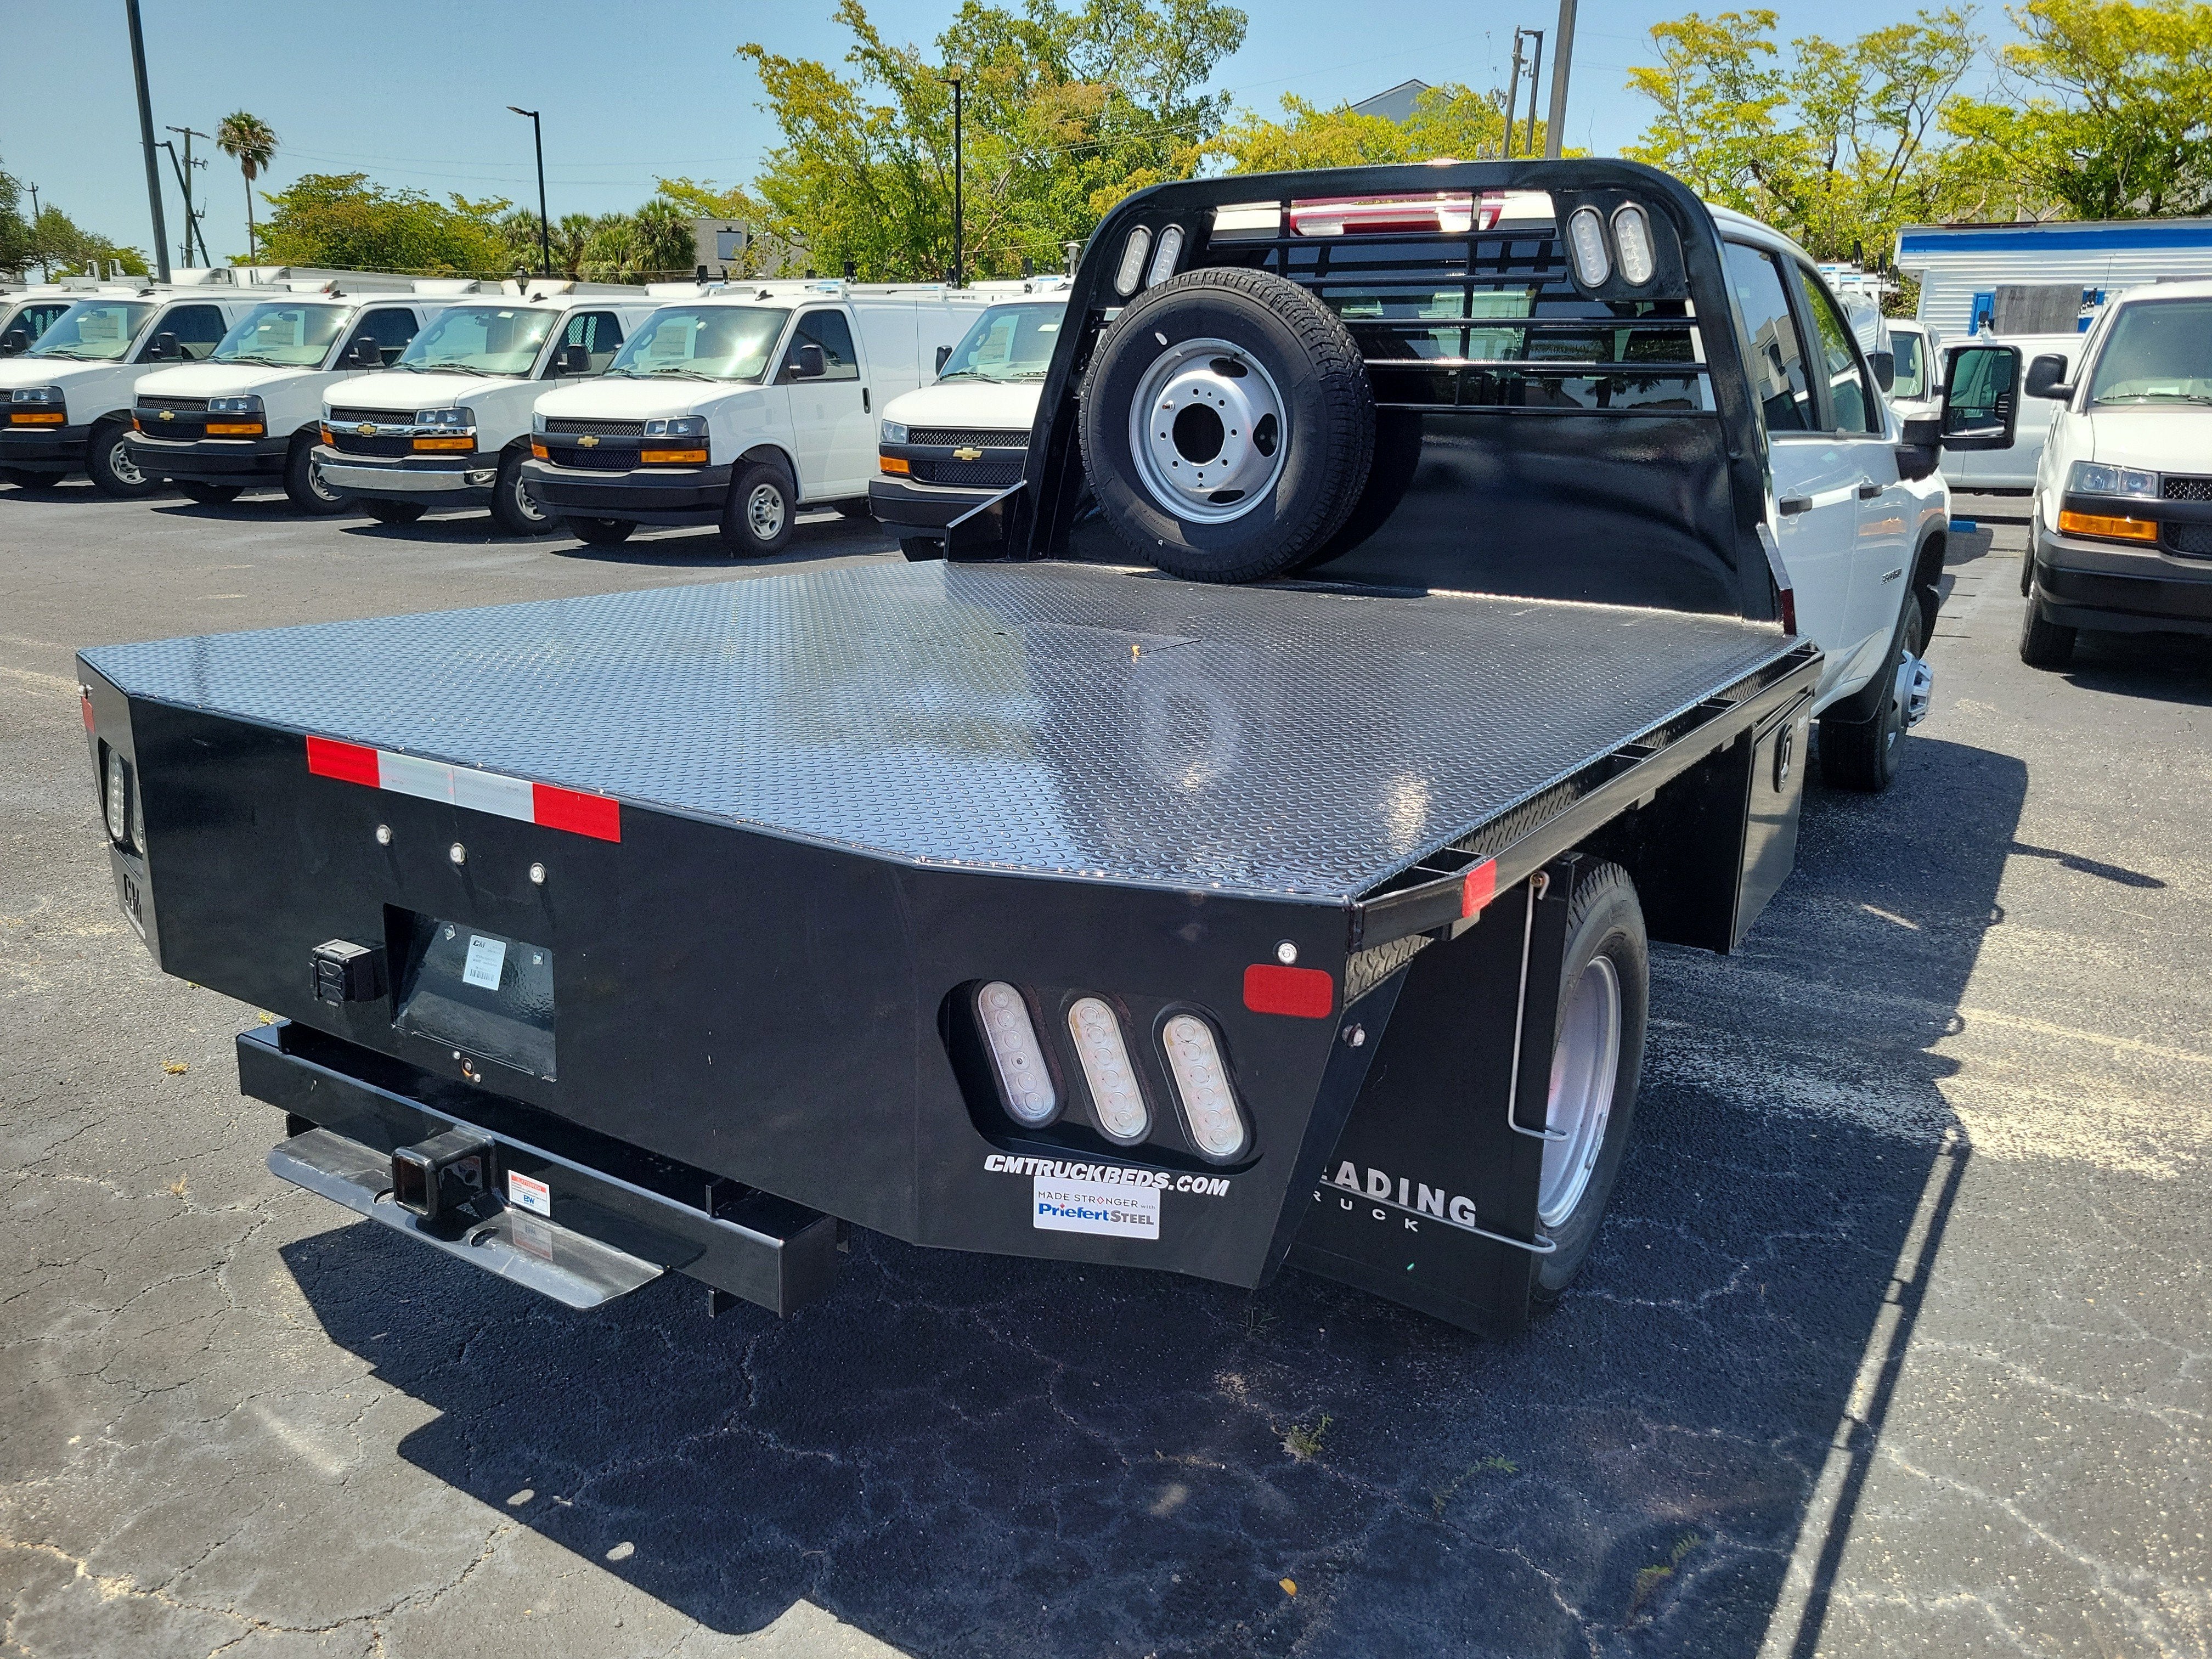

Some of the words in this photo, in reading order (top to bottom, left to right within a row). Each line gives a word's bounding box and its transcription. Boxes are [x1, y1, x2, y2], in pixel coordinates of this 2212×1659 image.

[984, 1154, 1230, 1197] CMTRUCKBEDS.COM
[1038, 1190, 1070, 1200] MADE
[1074, 1194, 1138, 1207] STRONGER
